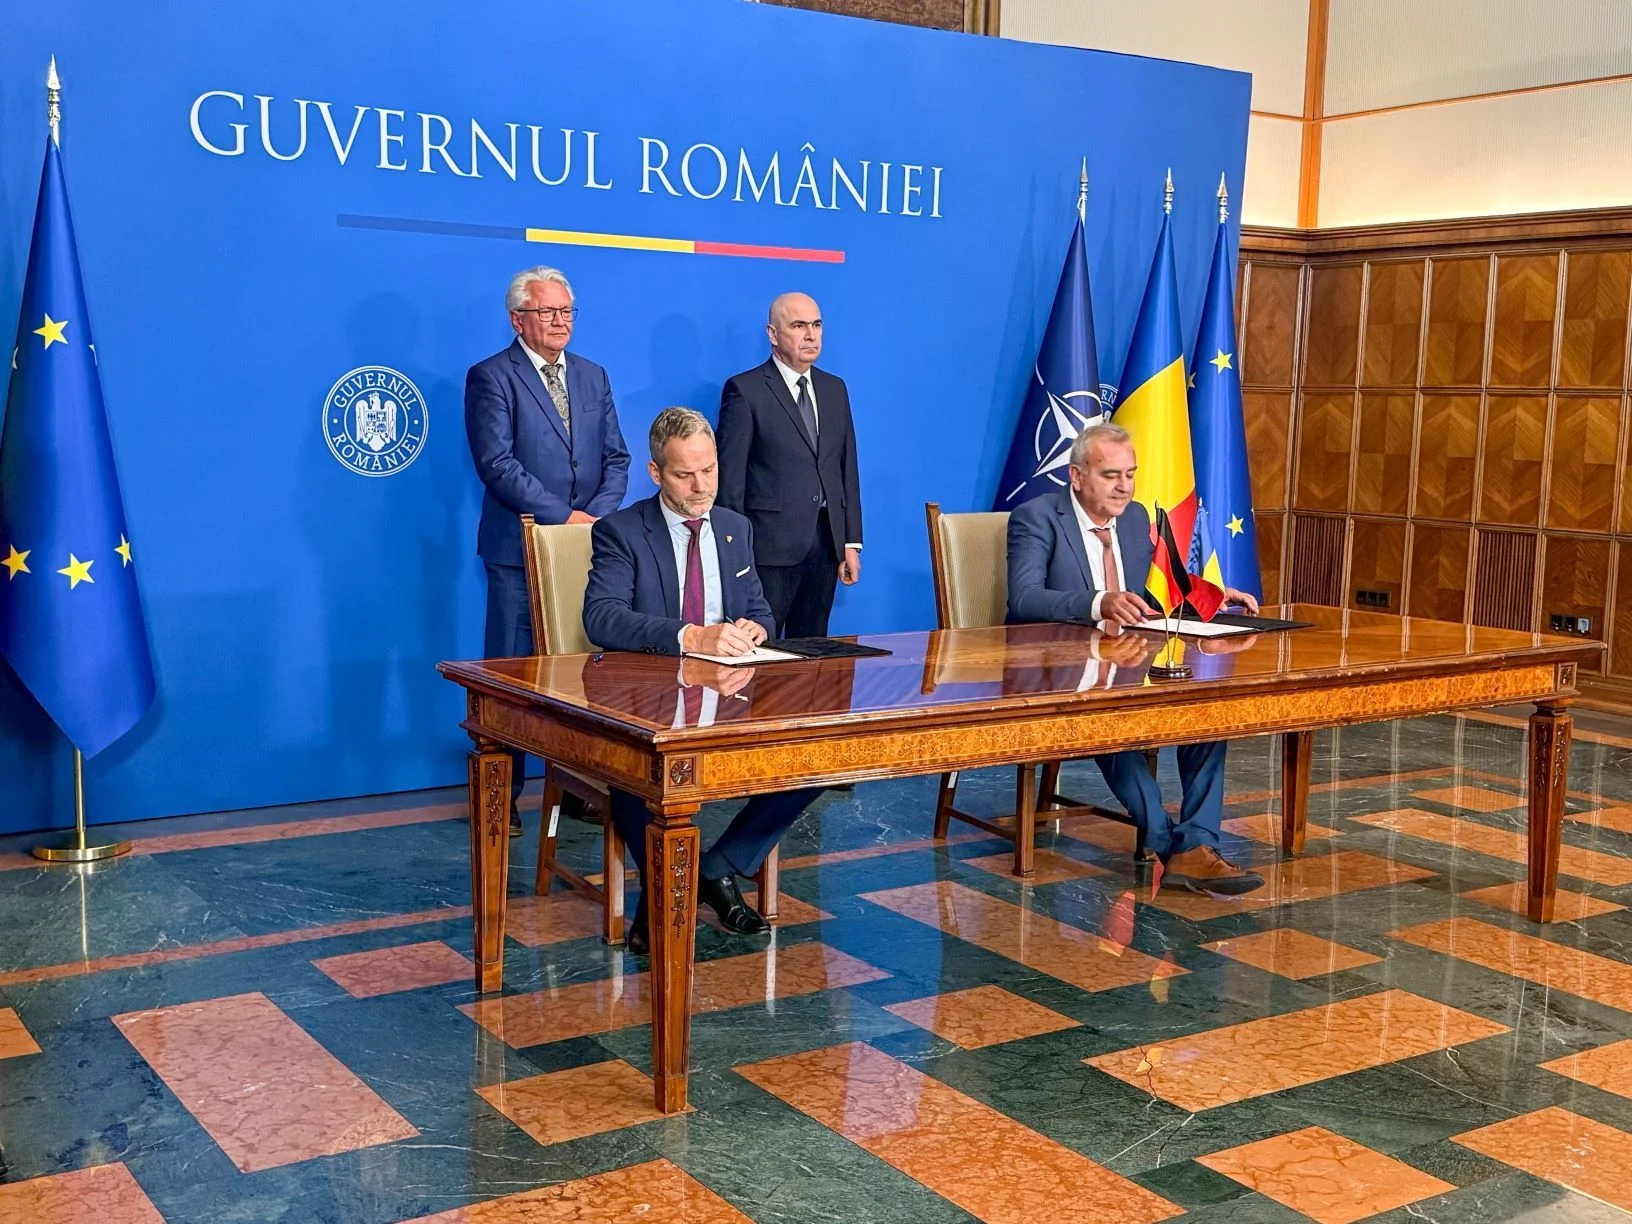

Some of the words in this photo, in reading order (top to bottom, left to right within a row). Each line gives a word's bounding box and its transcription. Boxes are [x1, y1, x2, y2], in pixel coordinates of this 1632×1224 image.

[189, 90, 613, 191] GUVERNUL
[638, 136, 946, 219] ROMÂNIEI
[333, 372, 417, 410] GUVERNUL
[333, 433, 420, 471] ROMÂNIEI
